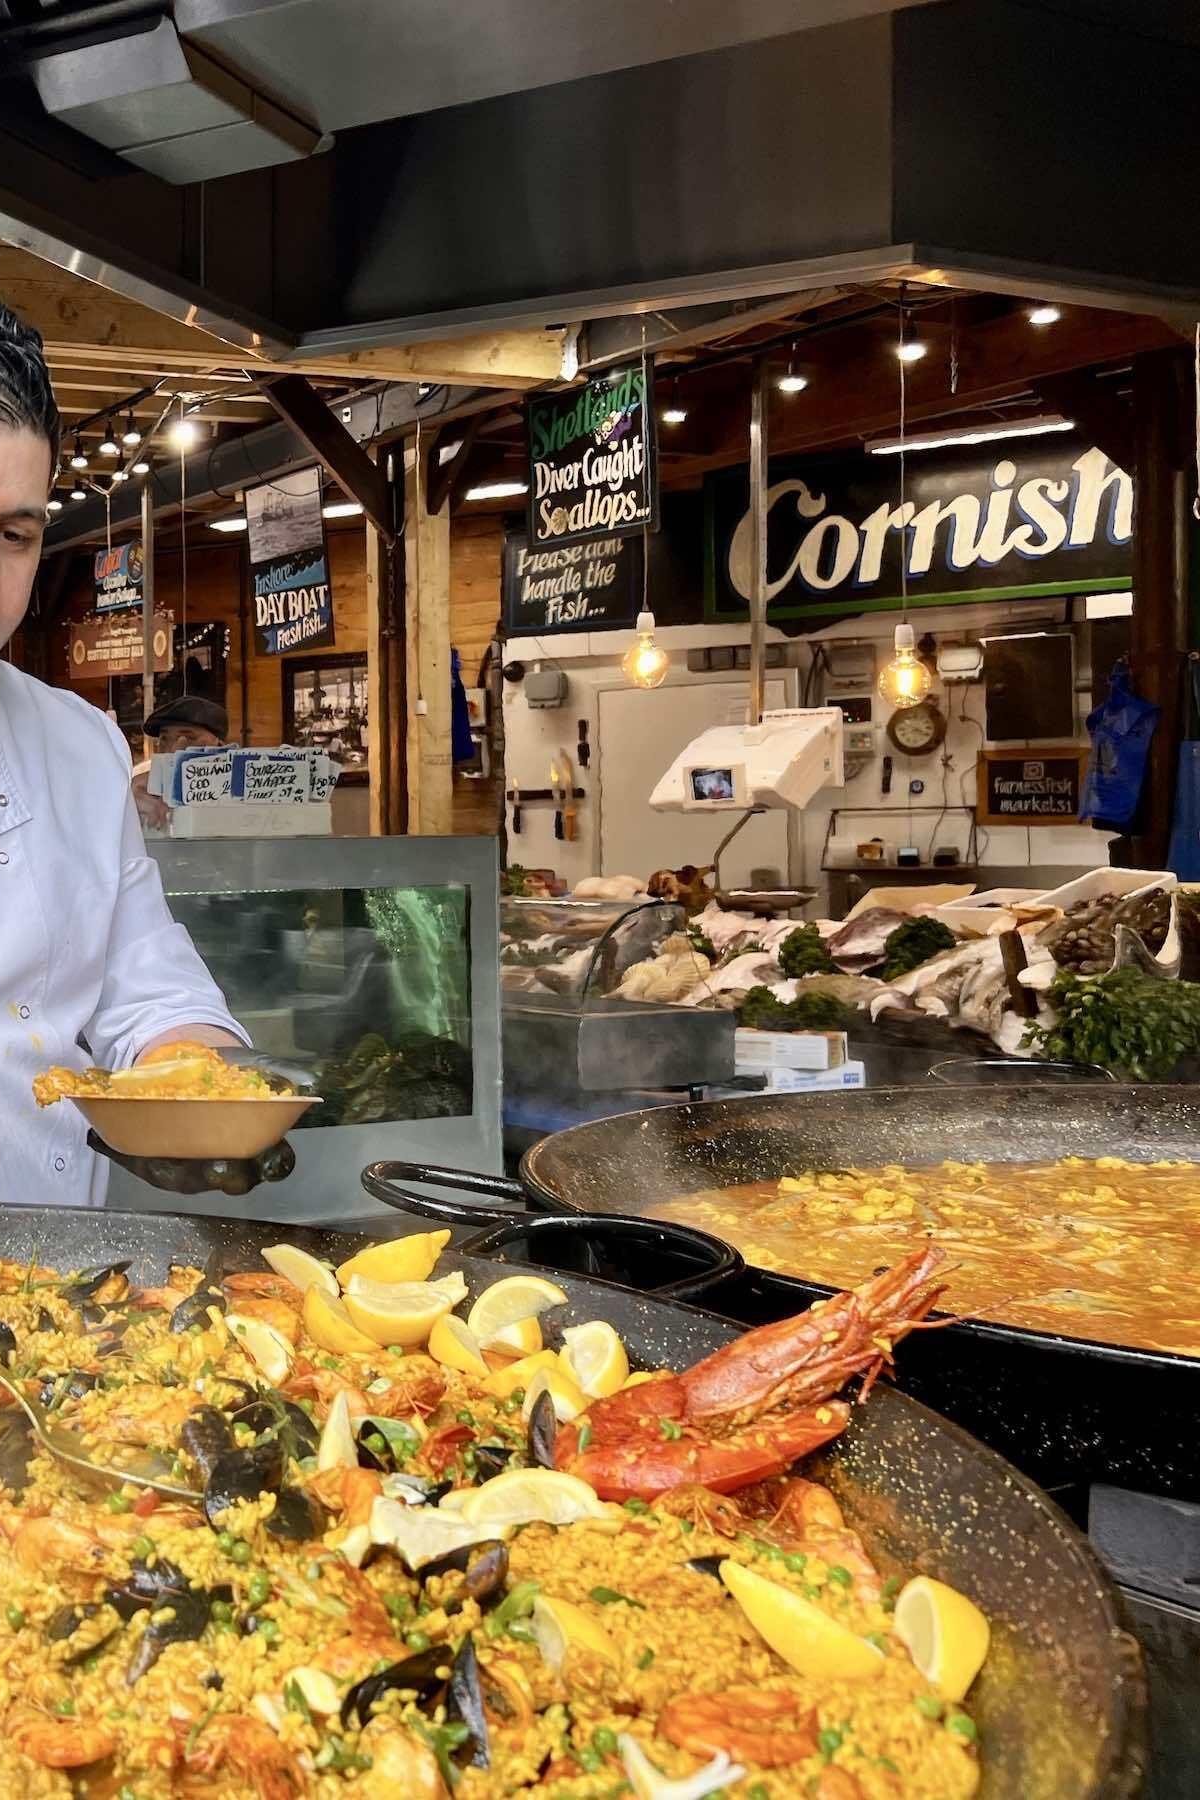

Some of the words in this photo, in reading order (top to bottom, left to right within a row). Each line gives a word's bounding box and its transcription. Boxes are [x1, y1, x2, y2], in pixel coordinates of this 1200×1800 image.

[532, 369, 645, 460] Shetlands
[534, 461, 582, 499] Diver
[582, 435, 644, 492] Caught
[729, 447, 1133, 600] Cornish
[255, 592, 286, 626] DAY
[287, 585, 328, 621] BOAT
[522, 567, 581, 604] handle
[585, 560, 616, 588] the
